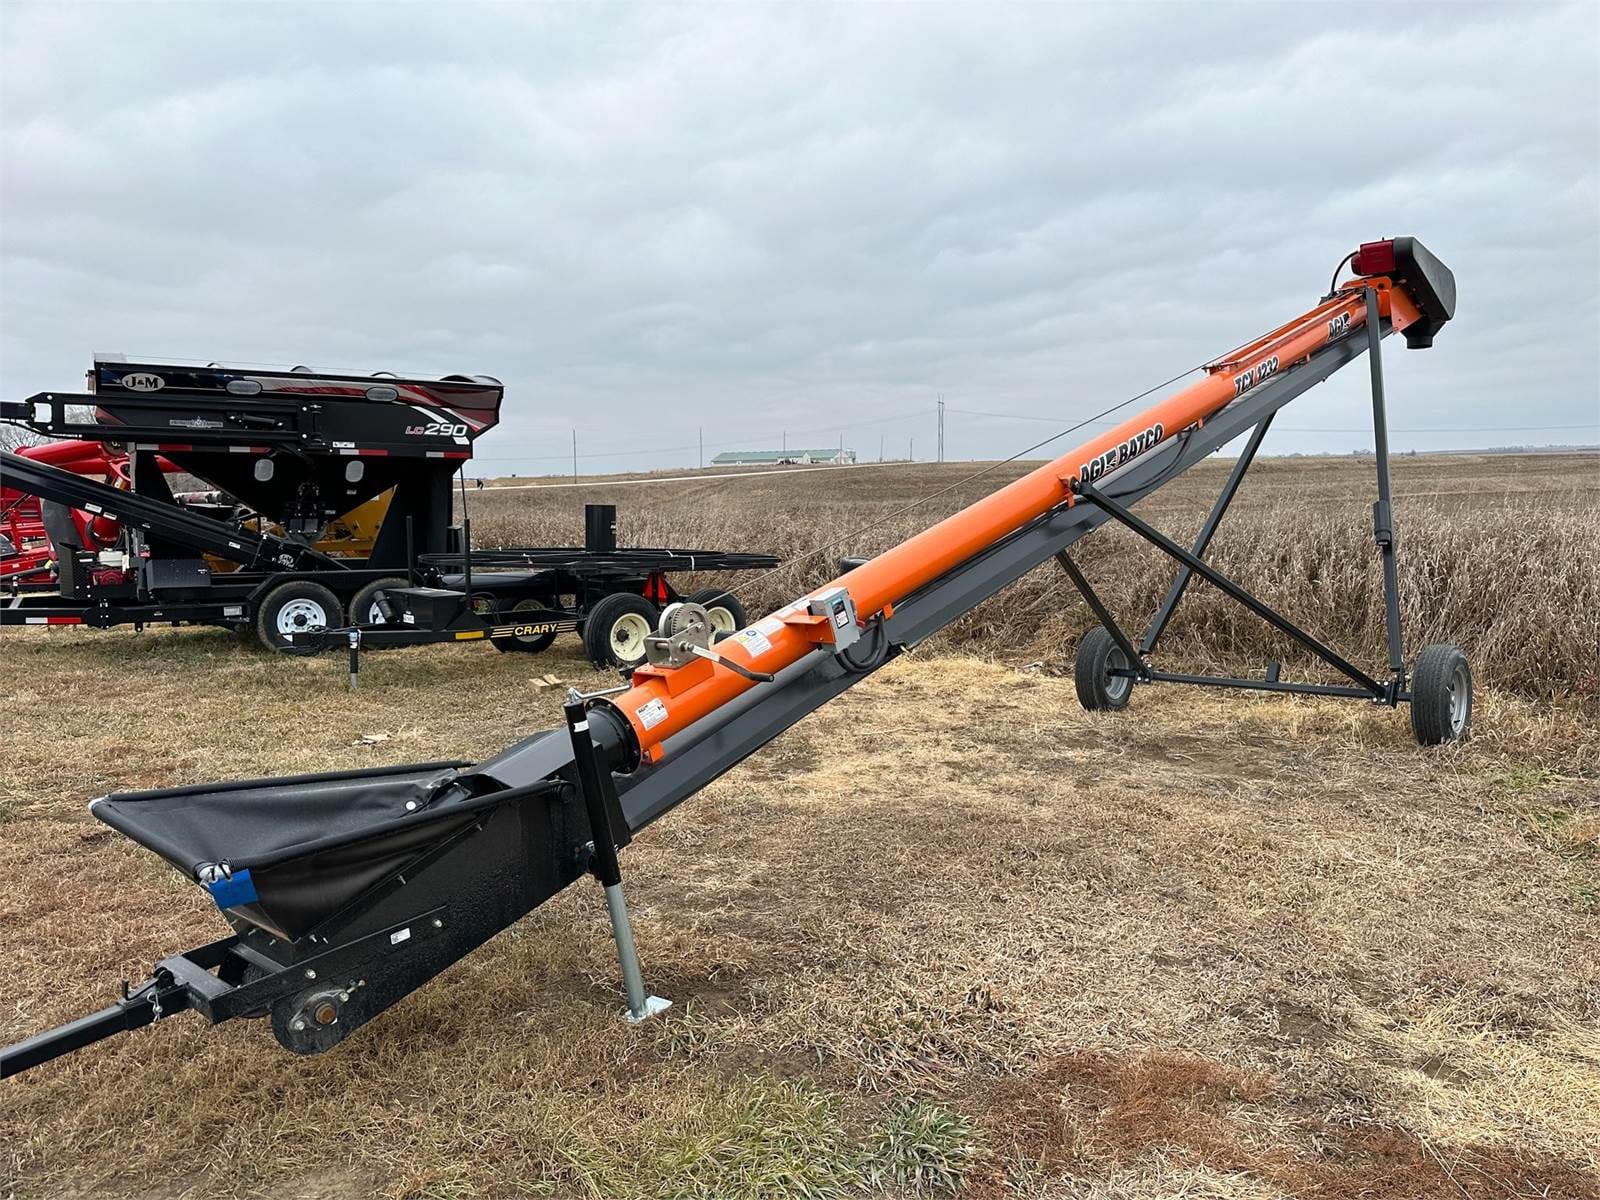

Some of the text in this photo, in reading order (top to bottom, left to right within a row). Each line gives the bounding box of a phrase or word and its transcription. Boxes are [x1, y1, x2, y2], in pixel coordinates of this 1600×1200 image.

[1328, 314, 1344, 339] AGI
[125, 376, 158, 388] J&M
[1234, 356, 1278, 395] TCX 1232
[1080, 424, 1164, 483] AGI BATCO
[514, 624, 557, 635] CRARY
